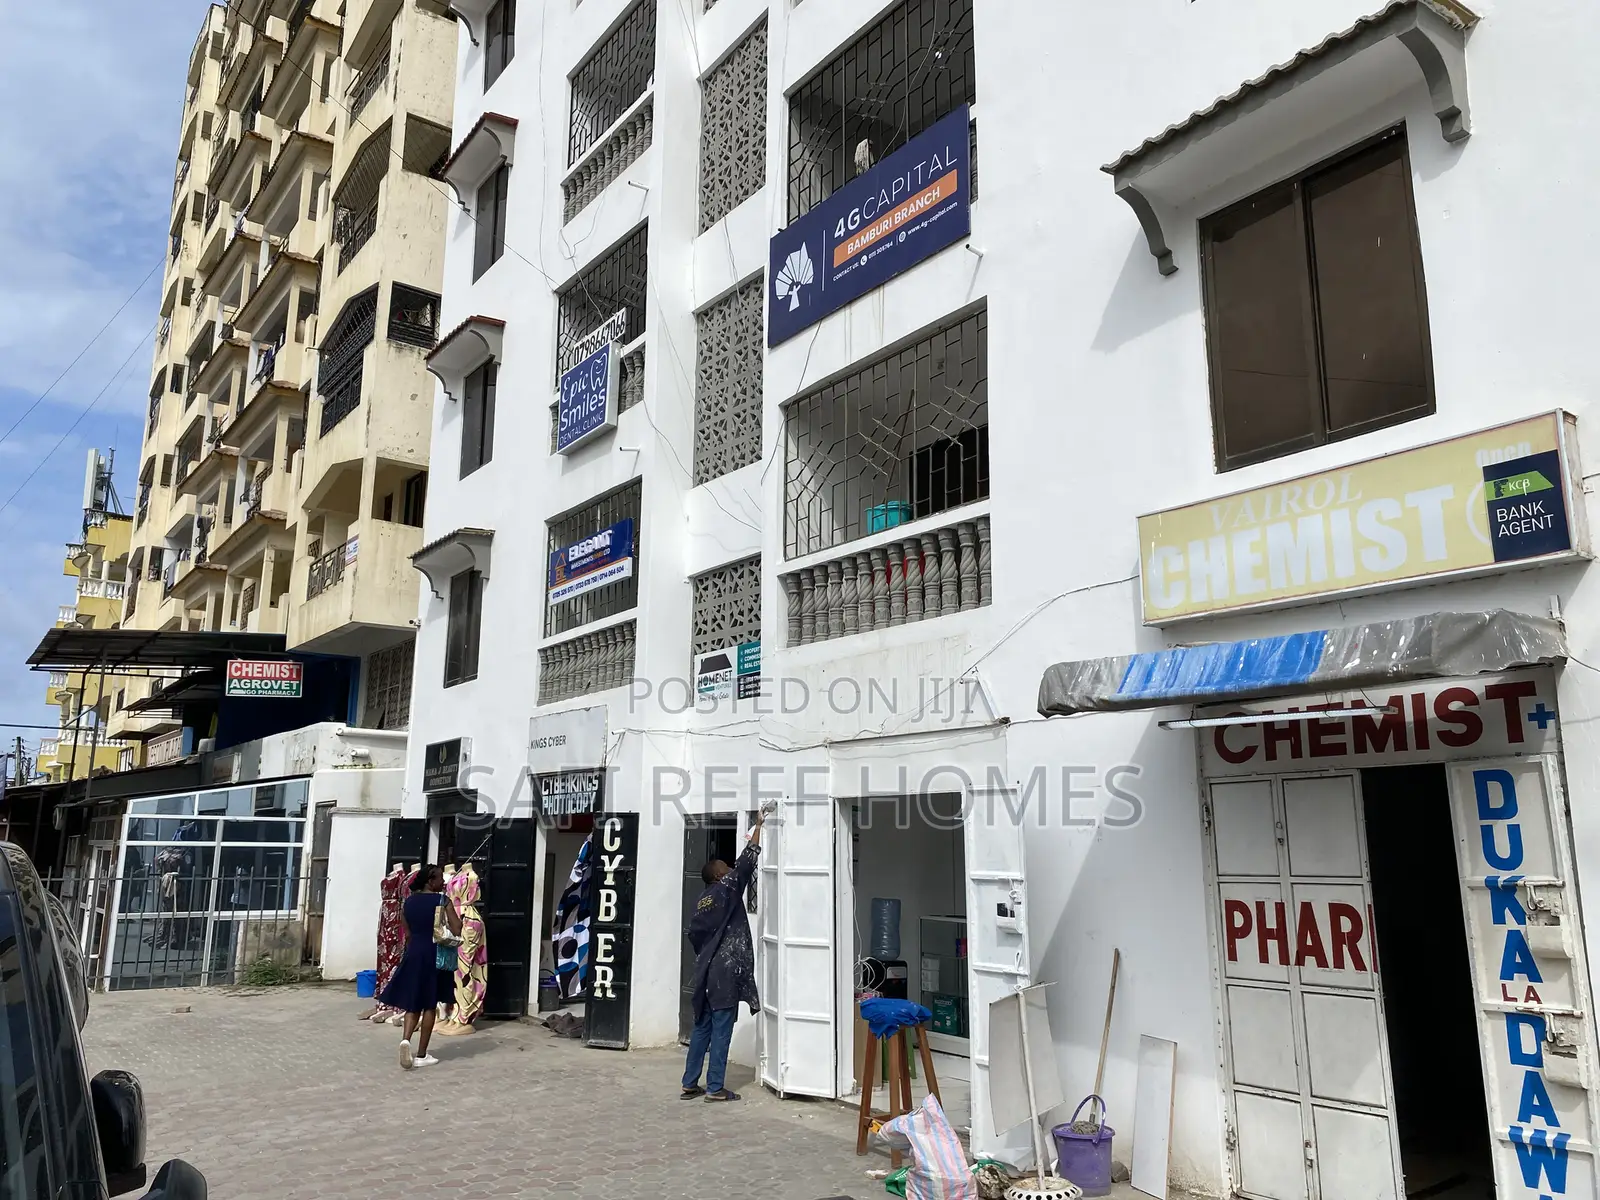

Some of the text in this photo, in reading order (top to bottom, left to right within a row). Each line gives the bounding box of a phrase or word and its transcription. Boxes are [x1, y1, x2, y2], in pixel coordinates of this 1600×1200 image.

[847, 186, 941, 255] BAMBURI BRANCH
[561, 370, 589, 407] Epic
[560, 387, 606, 432] Smiles
[559, 410, 604, 447] DENTAL CLINIC
[1208, 471, 1366, 532] VAIROL
[1496, 500, 1545, 522] BANK
[1498, 513, 1554, 538] AGENT
[1146, 484, 1455, 610] CHEMIST
[229, 679, 300, 690] AGROVET
[231, 662, 300, 678] CHEMIST
[697, 670, 733, 688] HOMENET
[1213, 680, 1538, 765] CHEMIST
[530, 735, 567, 749] KINGS CYBER
[542, 771, 599, 796] CYBERKINGS
[542, 791, 597, 816] PHOTOCOPY
[593, 817, 626, 1000] CYBER
[1224, 899, 1379, 975] PHAR
[1472, 769, 1572, 1200] DUKA LA DAW
